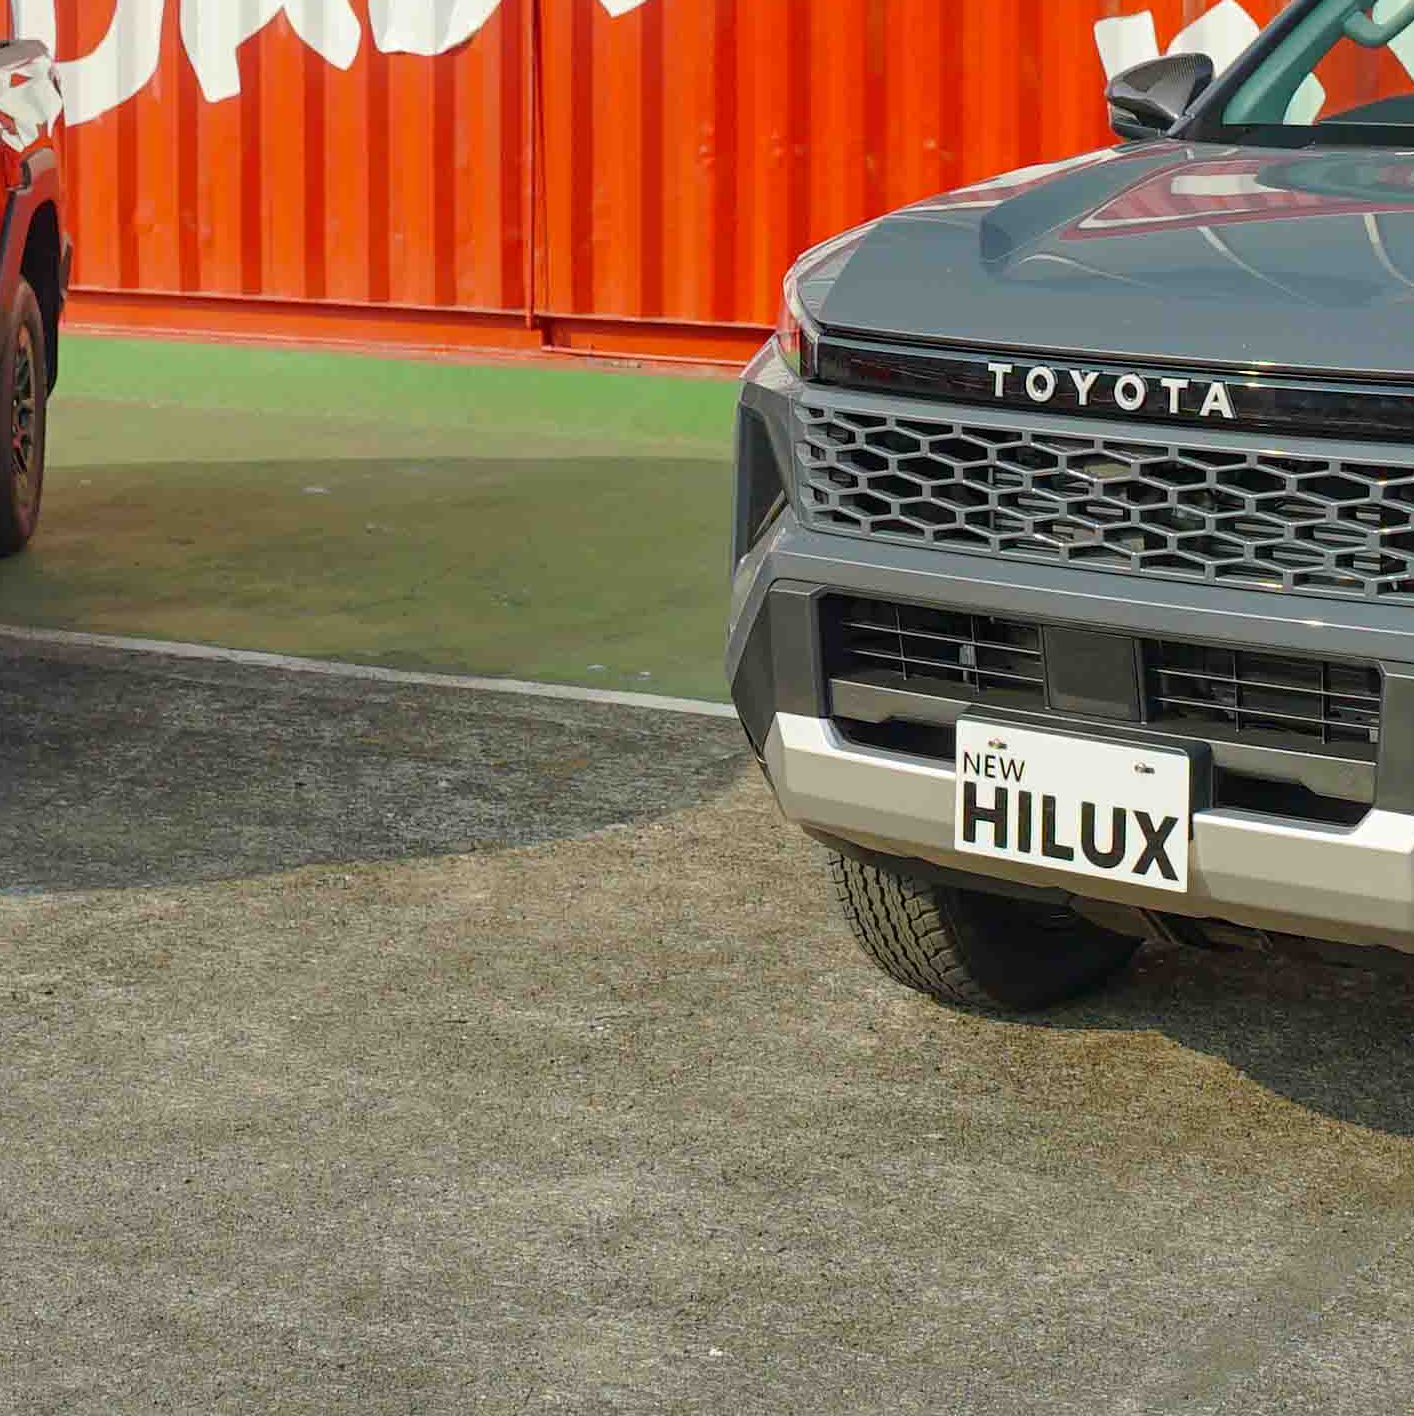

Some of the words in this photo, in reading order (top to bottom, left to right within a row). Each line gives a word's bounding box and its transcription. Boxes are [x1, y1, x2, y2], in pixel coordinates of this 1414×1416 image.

[987, 361, 1237, 420] TOYOTA
[962, 751, 1026, 783] NEW
[962, 780, 1180, 882] HILUX
